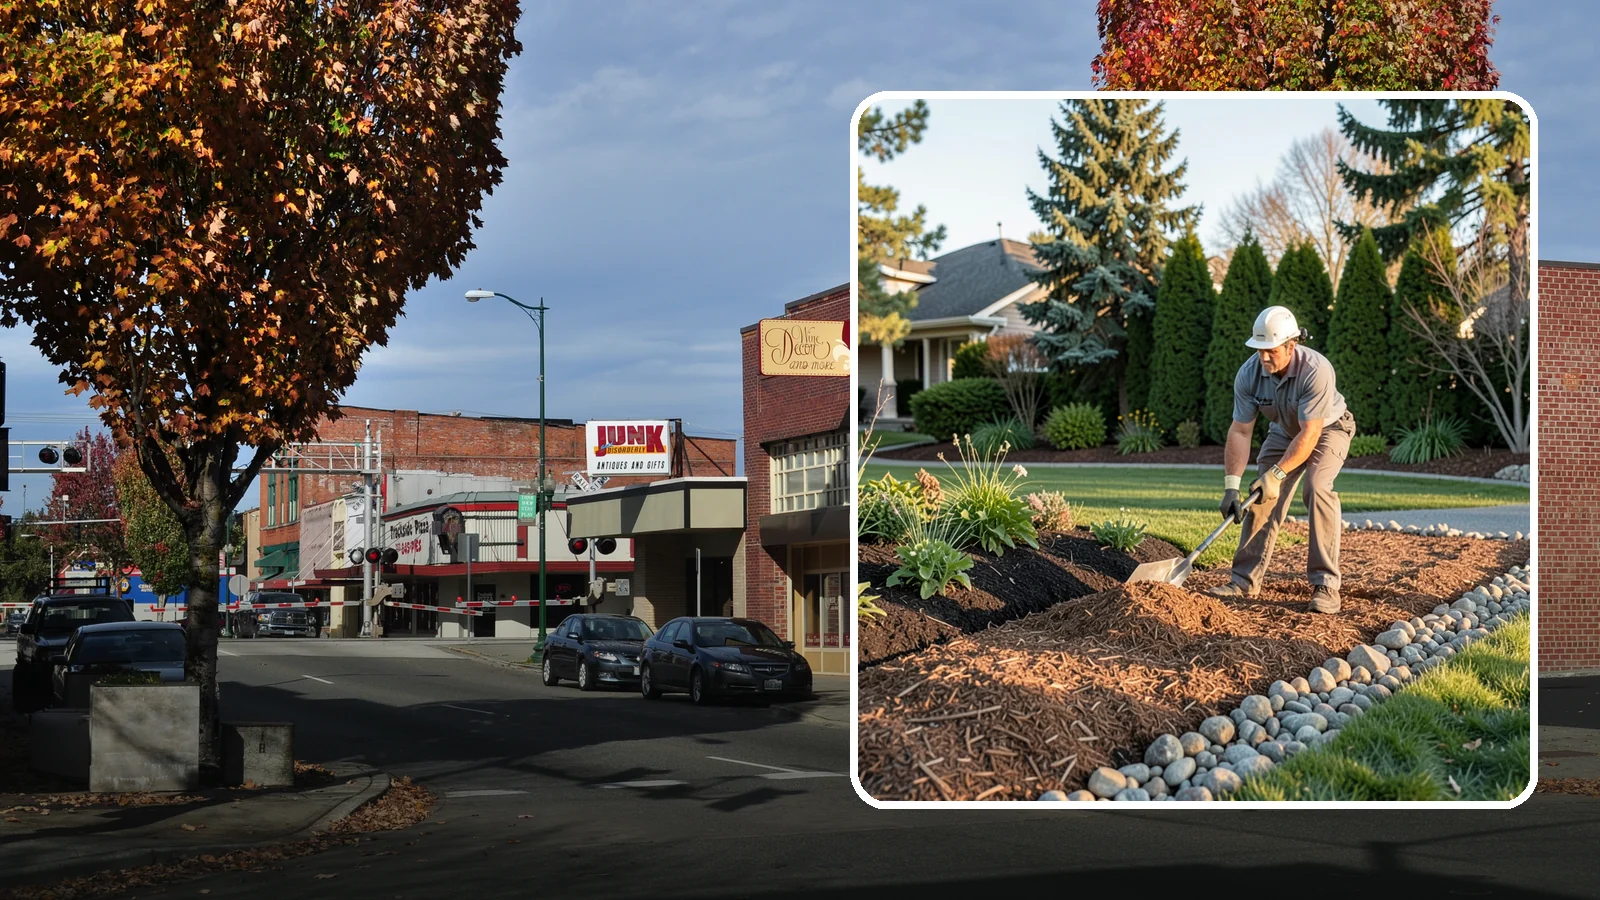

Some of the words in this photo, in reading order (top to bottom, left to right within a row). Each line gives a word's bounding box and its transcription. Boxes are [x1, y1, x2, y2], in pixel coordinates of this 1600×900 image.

[596, 425, 665, 457] JUNK
[607, 446, 646, 454] DISORDERLY
[597, 461, 628, 470] ANTIQUES
[631, 461, 644, 469] AND
[647, 460, 665, 469] GIFTS
[414, 519, 428, 534] Pizza
